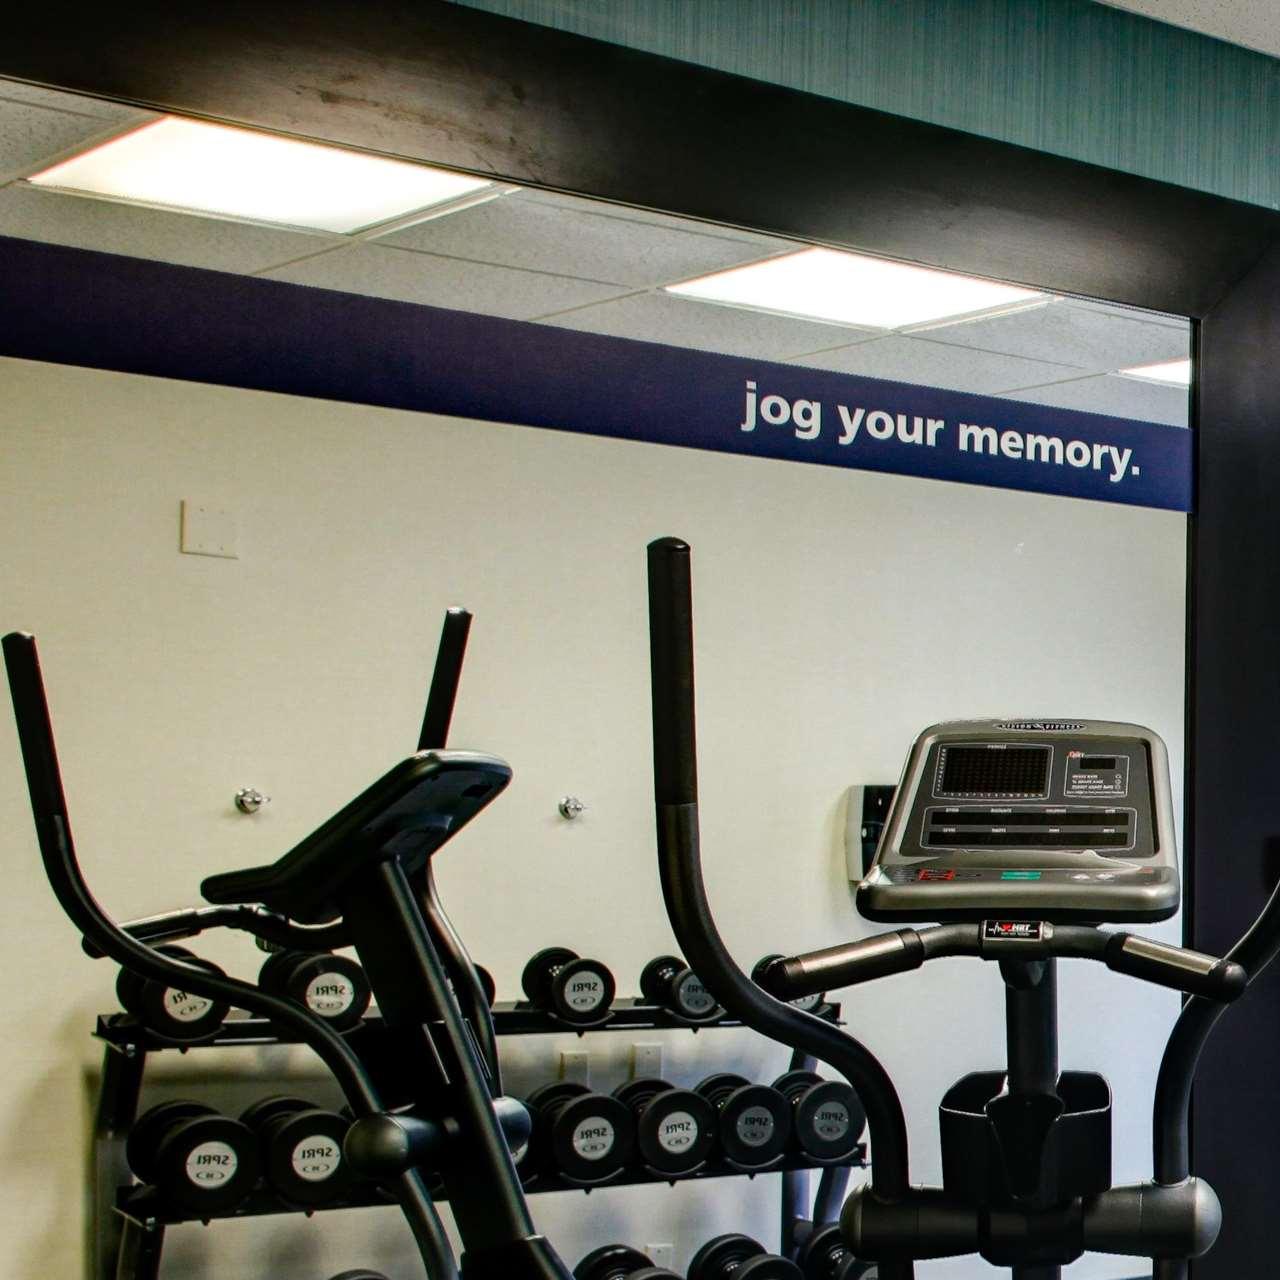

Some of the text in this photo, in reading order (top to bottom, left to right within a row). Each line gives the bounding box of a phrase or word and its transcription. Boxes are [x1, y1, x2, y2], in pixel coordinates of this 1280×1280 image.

[740, 379, 1141, 483] jog your memory.
